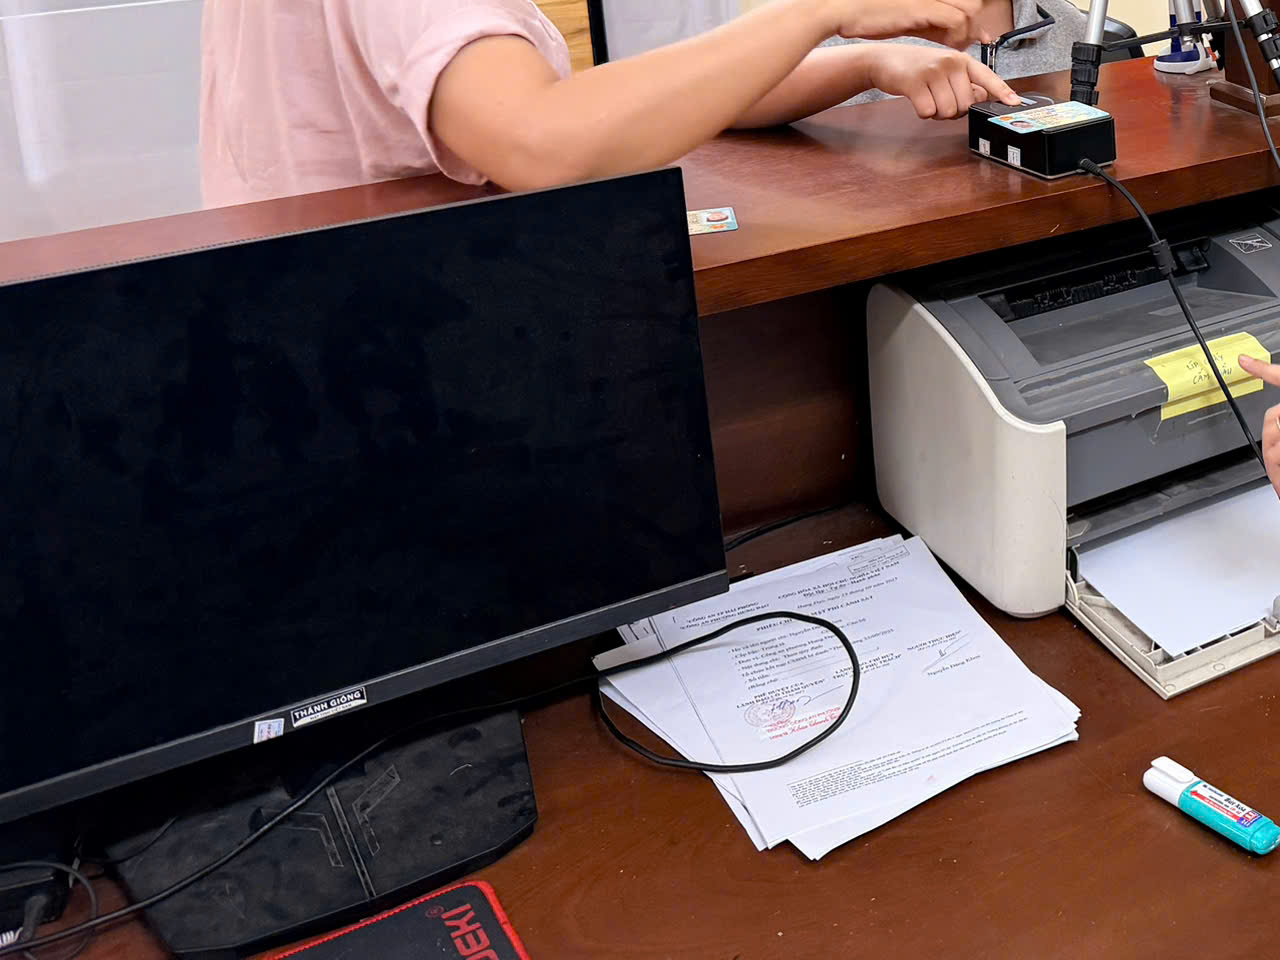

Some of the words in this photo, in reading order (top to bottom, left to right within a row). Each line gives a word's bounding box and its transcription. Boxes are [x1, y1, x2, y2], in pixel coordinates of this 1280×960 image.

[294, 701, 328, 720] THÁNH
[330, 690, 361, 708] GIÓNG
[441, 903, 502, 960] EKI
